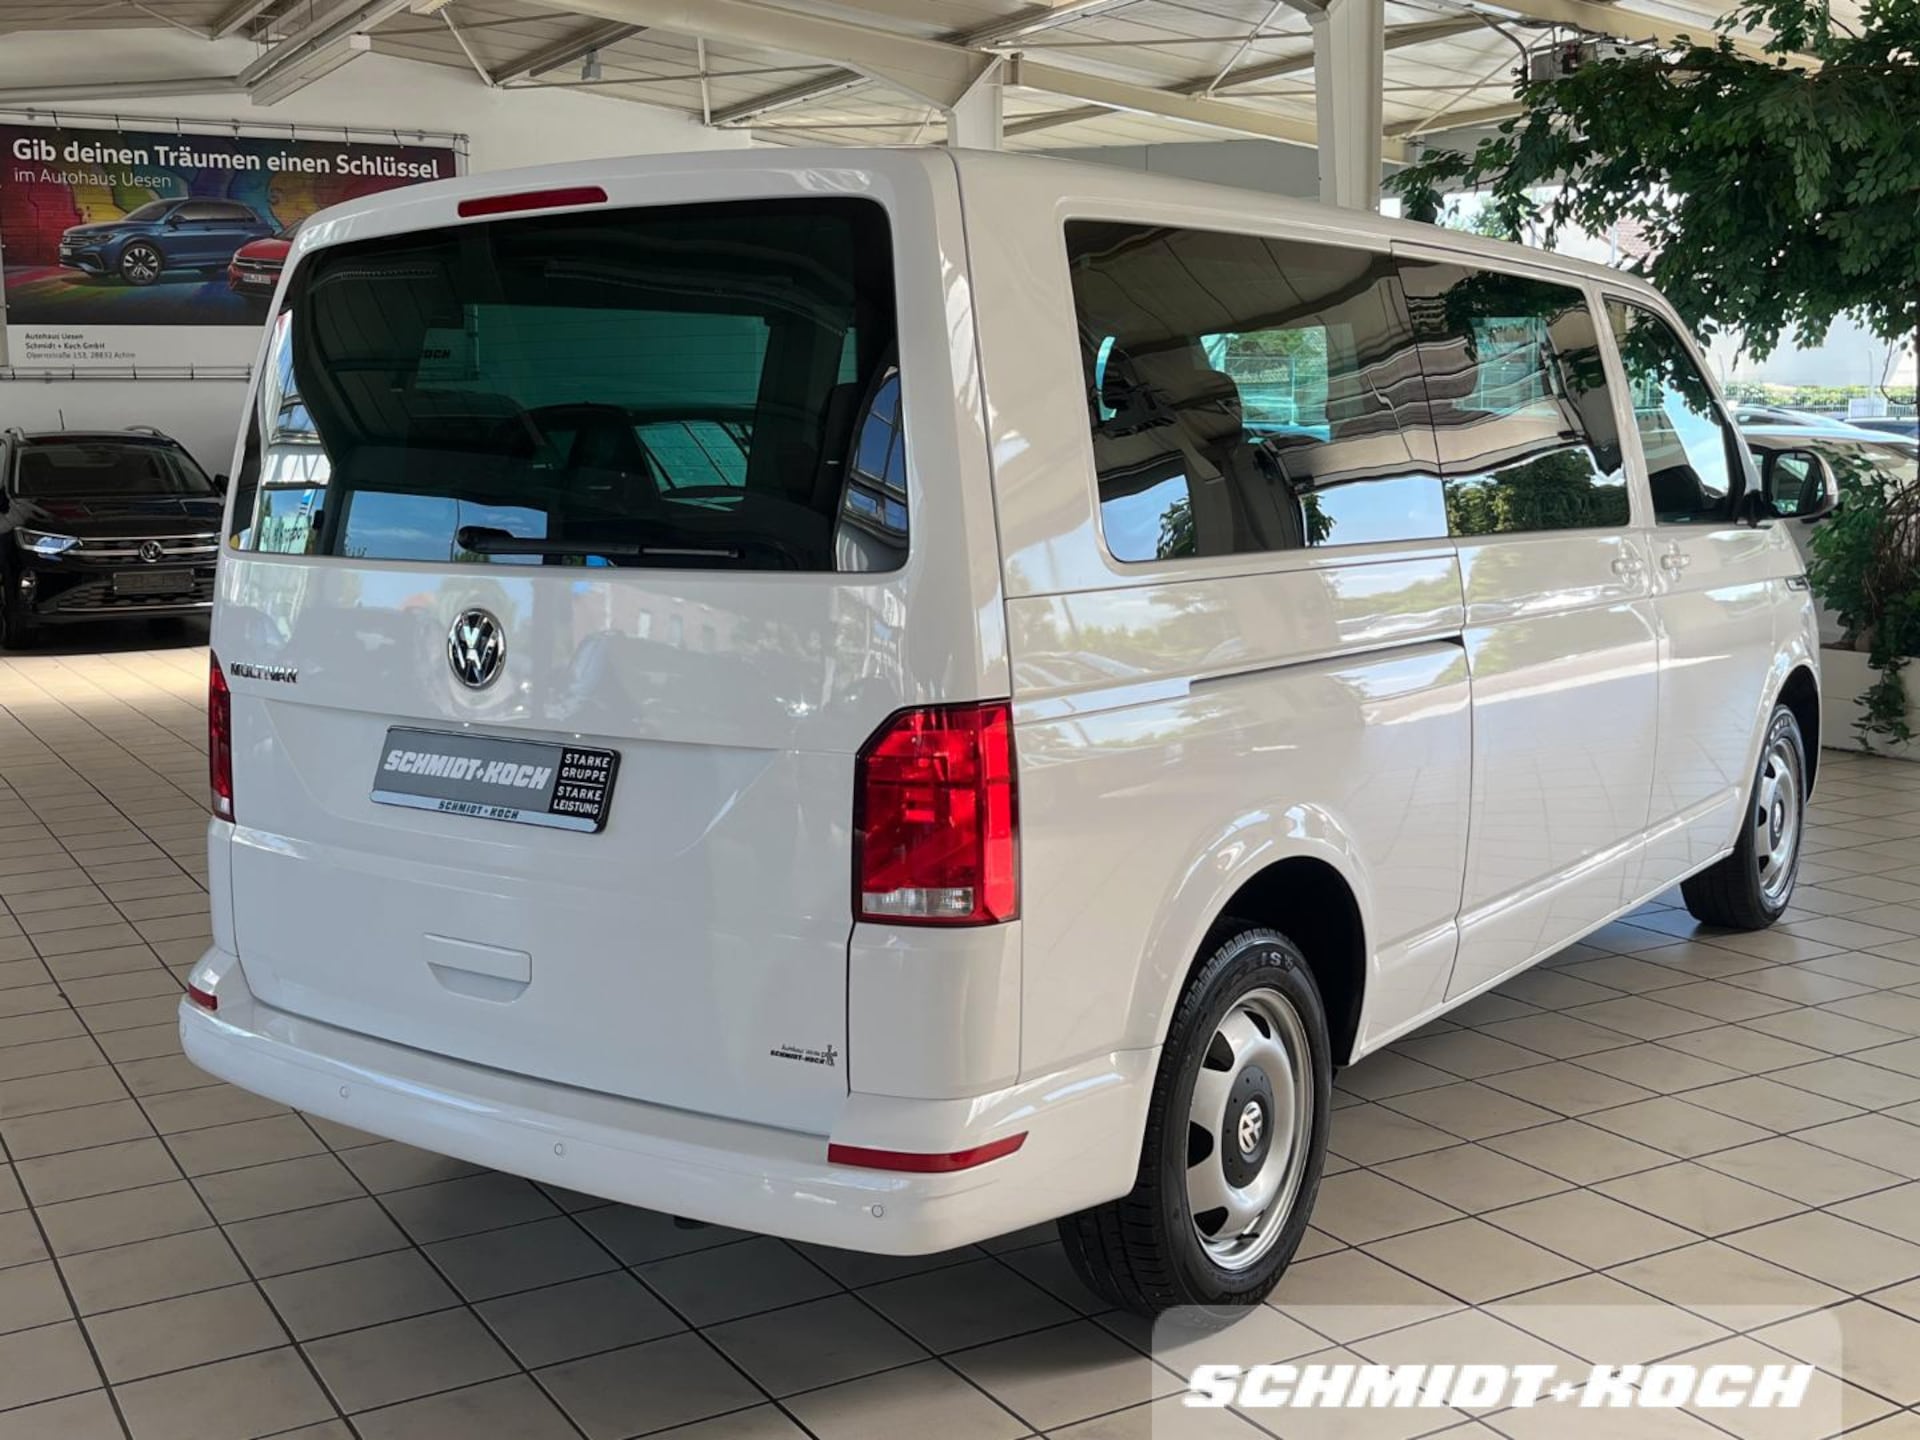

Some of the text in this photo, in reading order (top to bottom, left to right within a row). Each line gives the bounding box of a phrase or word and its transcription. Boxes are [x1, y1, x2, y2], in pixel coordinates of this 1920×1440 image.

[12, 138, 440, 179] Gib deinen Träumen einen Schlüssel
[14, 167, 172, 188] im Autohaus Uesen
[230, 661, 299, 683] MULTIVAN
[564, 753, 610, 768] STARKE
[562, 767, 607, 782] GRUPPE
[557, 786, 602, 801] STARKE
[438, 801, 483, 815] SCHMIDT
[490, 808, 519, 820] KOCH
[553, 798, 599, 815] LEISTUNG
